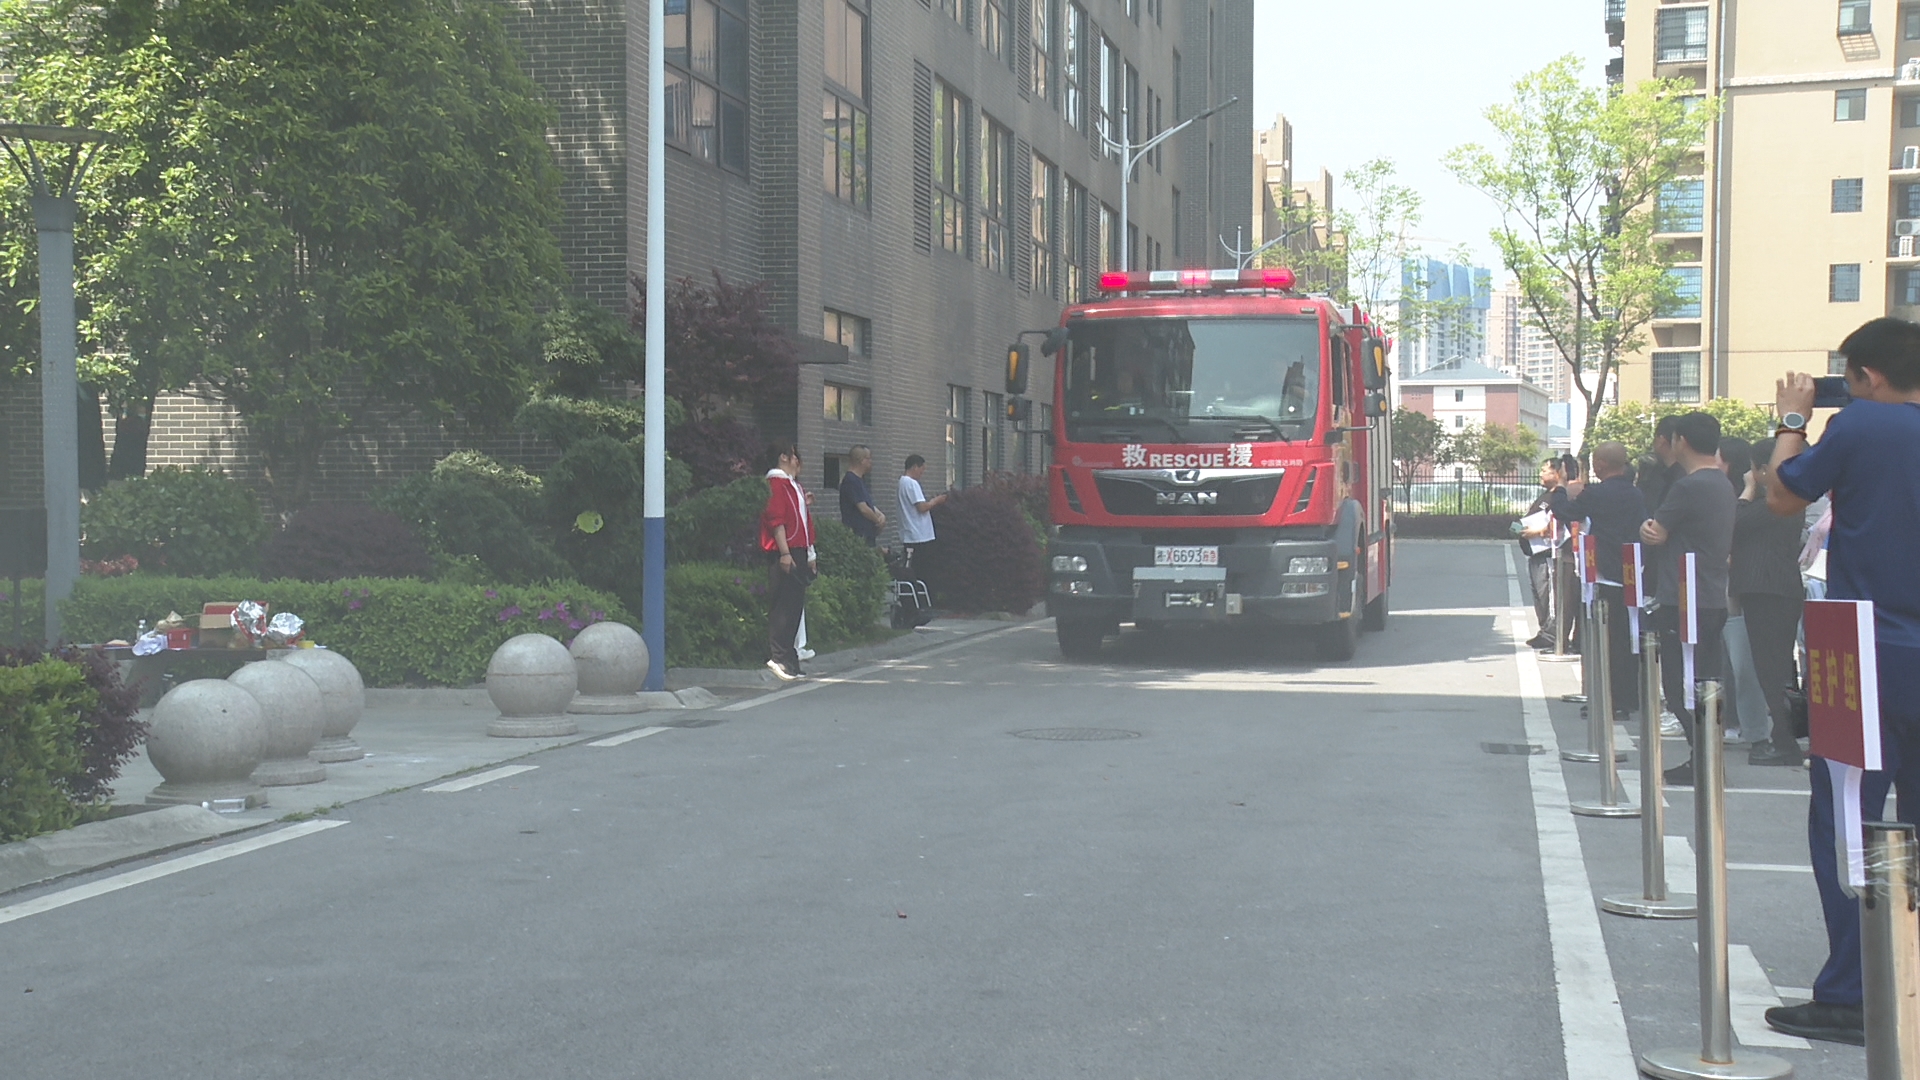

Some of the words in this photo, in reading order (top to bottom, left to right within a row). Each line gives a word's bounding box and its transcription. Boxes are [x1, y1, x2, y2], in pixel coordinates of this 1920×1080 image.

[1122, 444, 1147, 467] 救
[1150, 454, 1224, 467] RESCUE
[1227, 443, 1253, 467] 援
[1156, 492, 1218, 505] MAN
